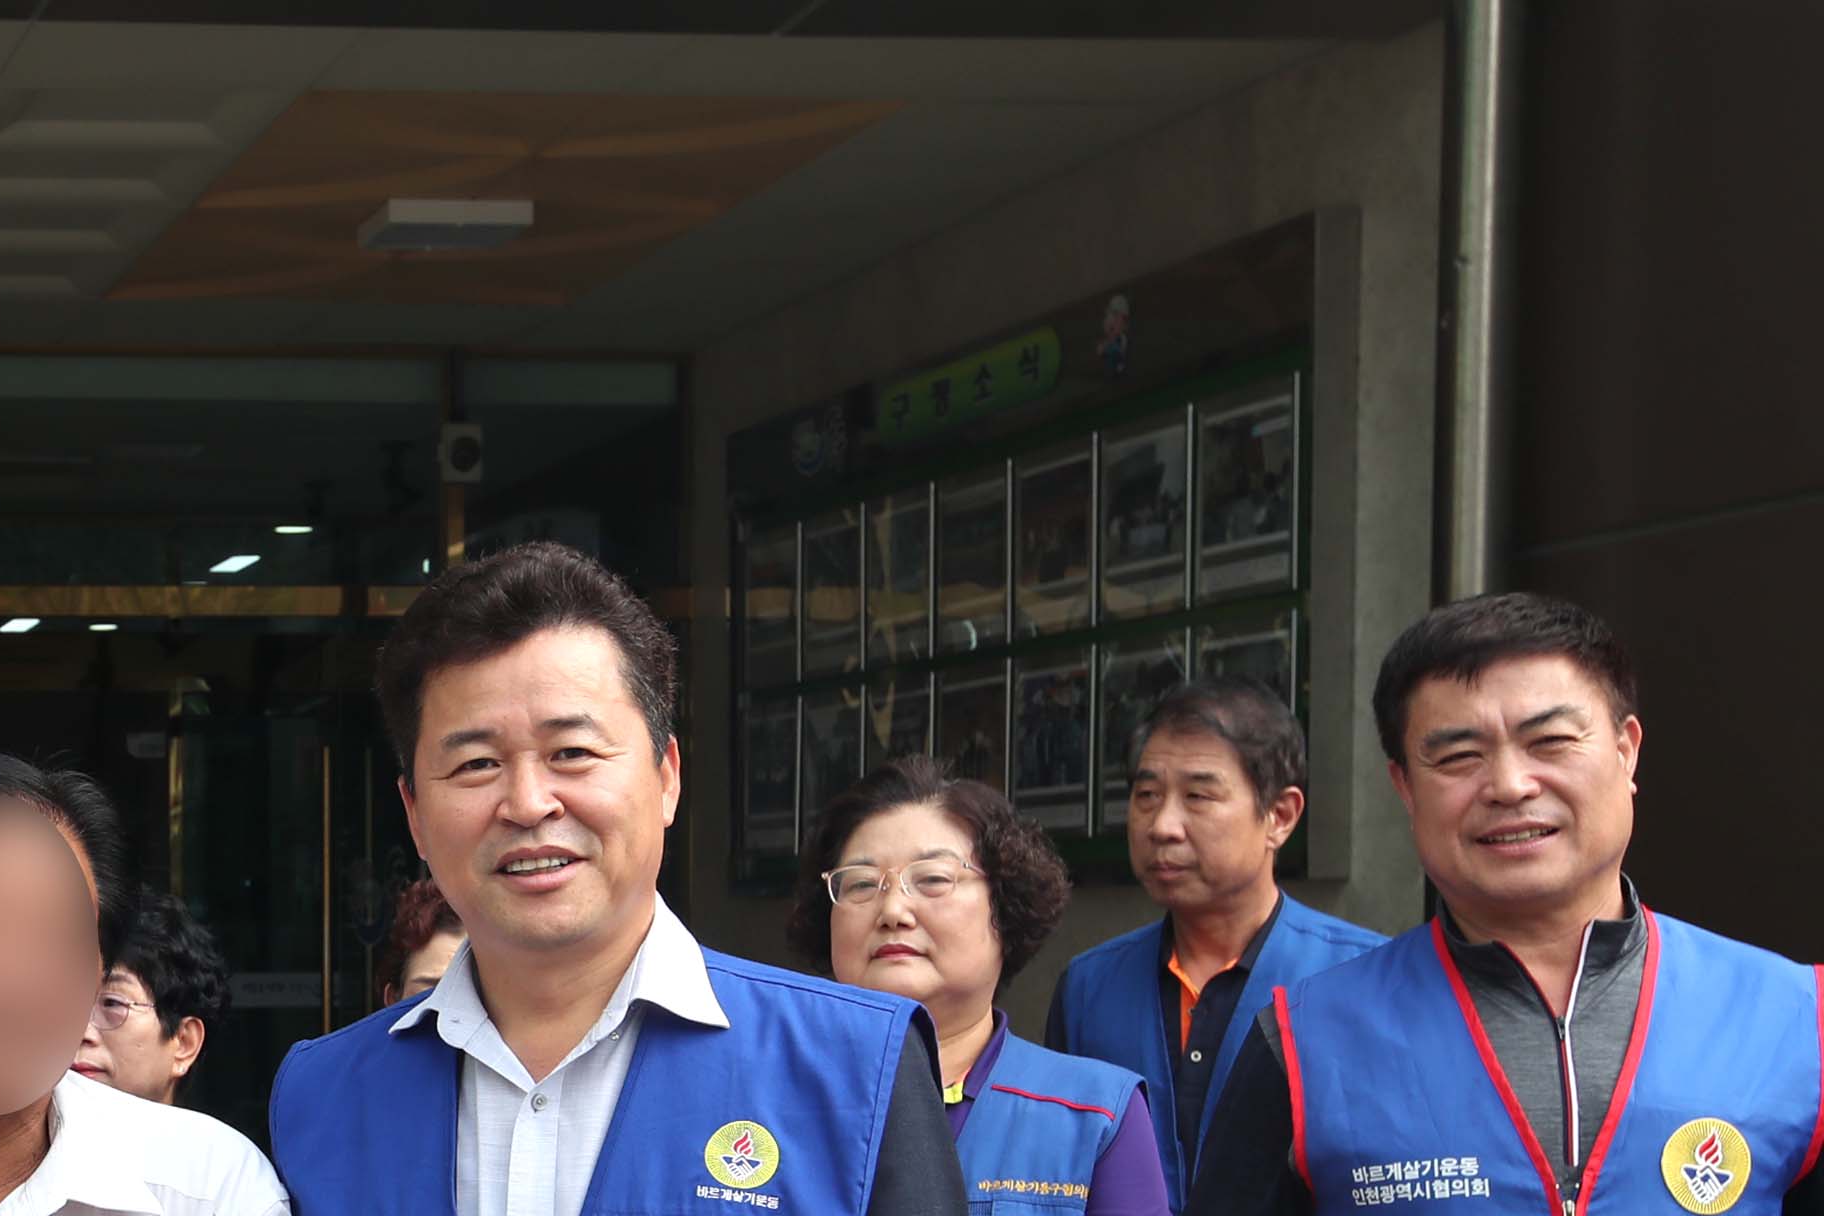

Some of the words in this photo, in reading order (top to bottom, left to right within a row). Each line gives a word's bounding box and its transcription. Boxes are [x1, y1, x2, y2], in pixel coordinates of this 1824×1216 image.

[1351, 1157, 1480, 1184] 바르게살기운동
[694, 1184, 781, 1210] 바르게살기운동
[1351, 1178, 1491, 1206] 인천광역시협의회
